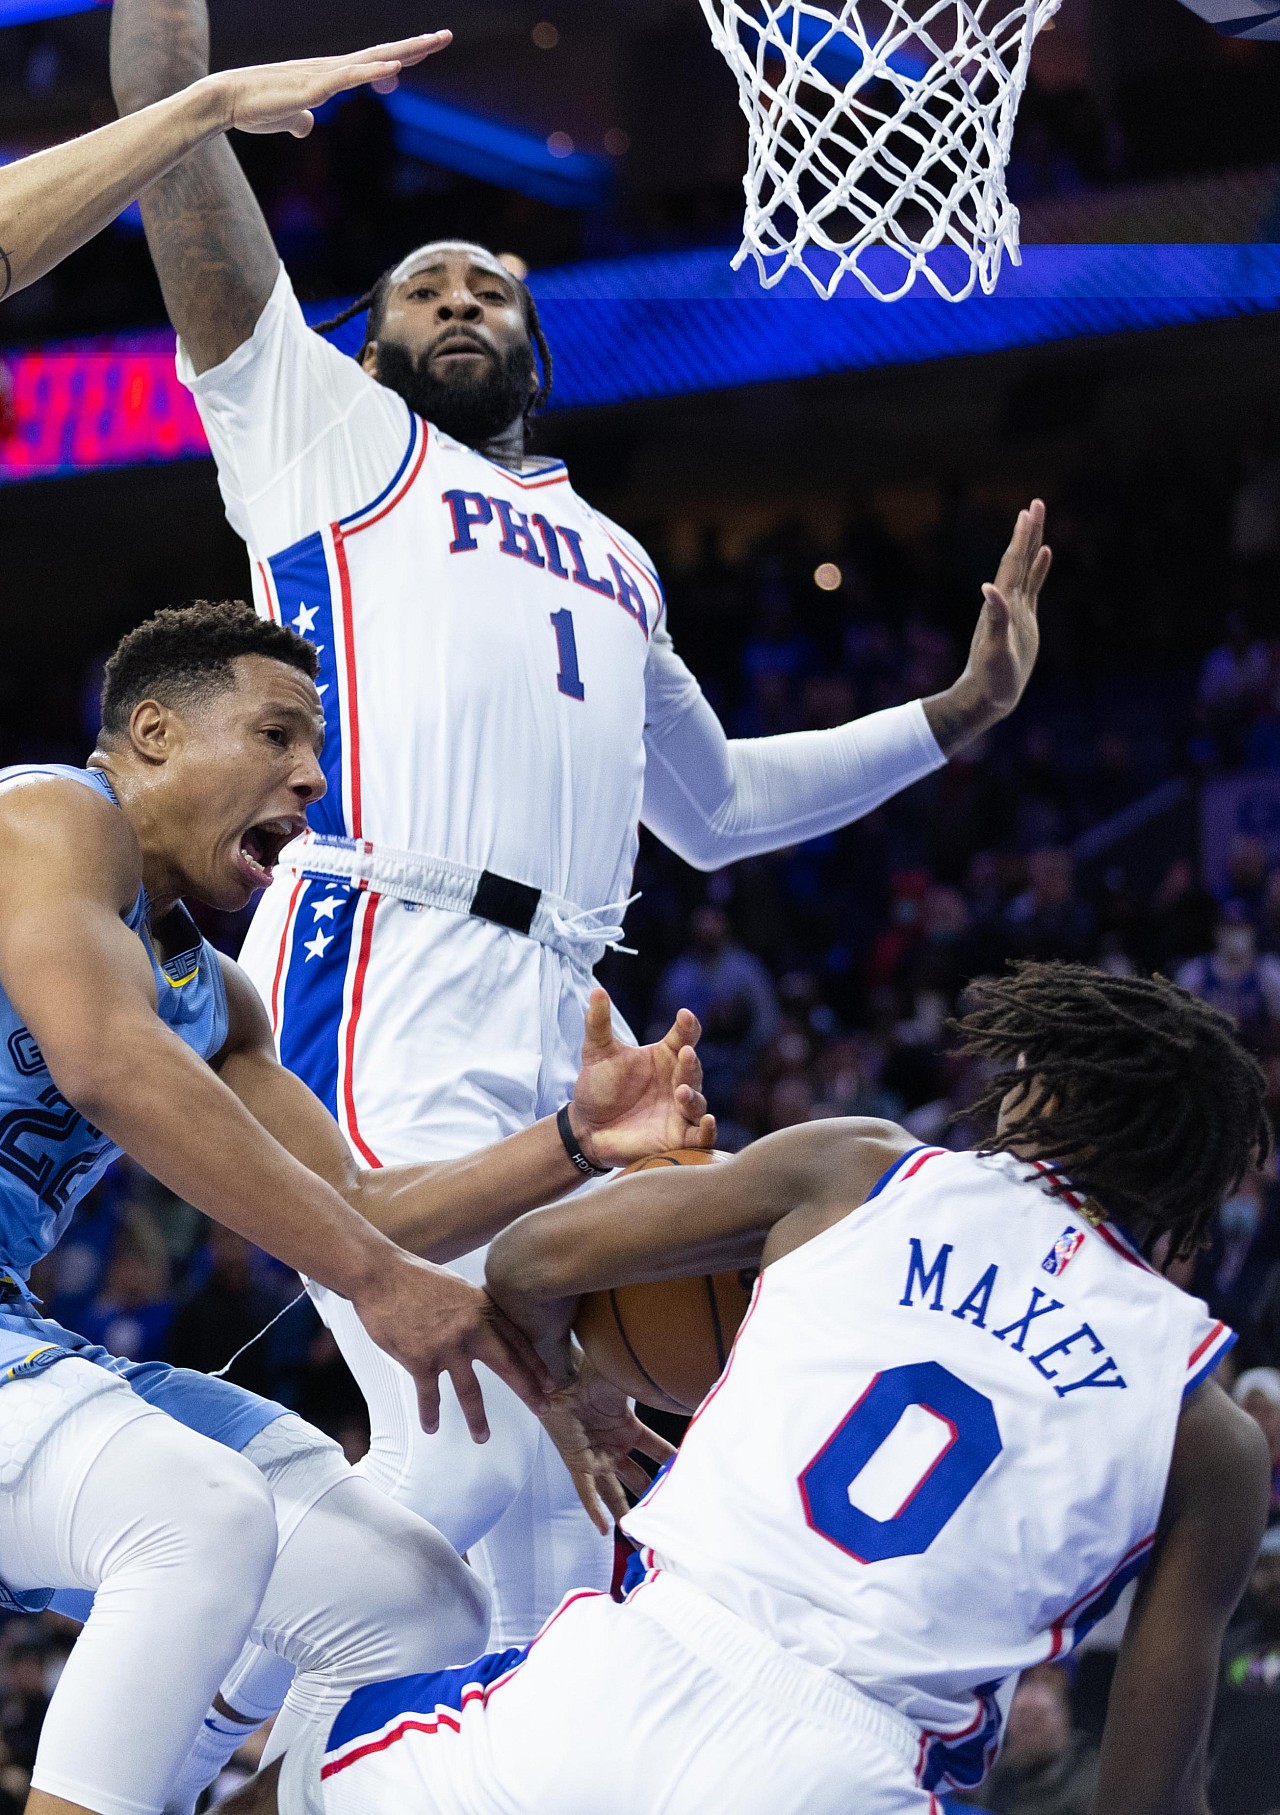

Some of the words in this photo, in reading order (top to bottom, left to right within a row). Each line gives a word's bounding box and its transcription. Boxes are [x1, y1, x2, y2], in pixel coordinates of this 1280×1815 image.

[4, 350, 208, 476] EFENS
[441, 489, 649, 642] PHILA
[549, 607, 585, 702] 1
[899, 1238, 1127, 1398] MAXEY
[797, 1360, 1003, 1565] 0
